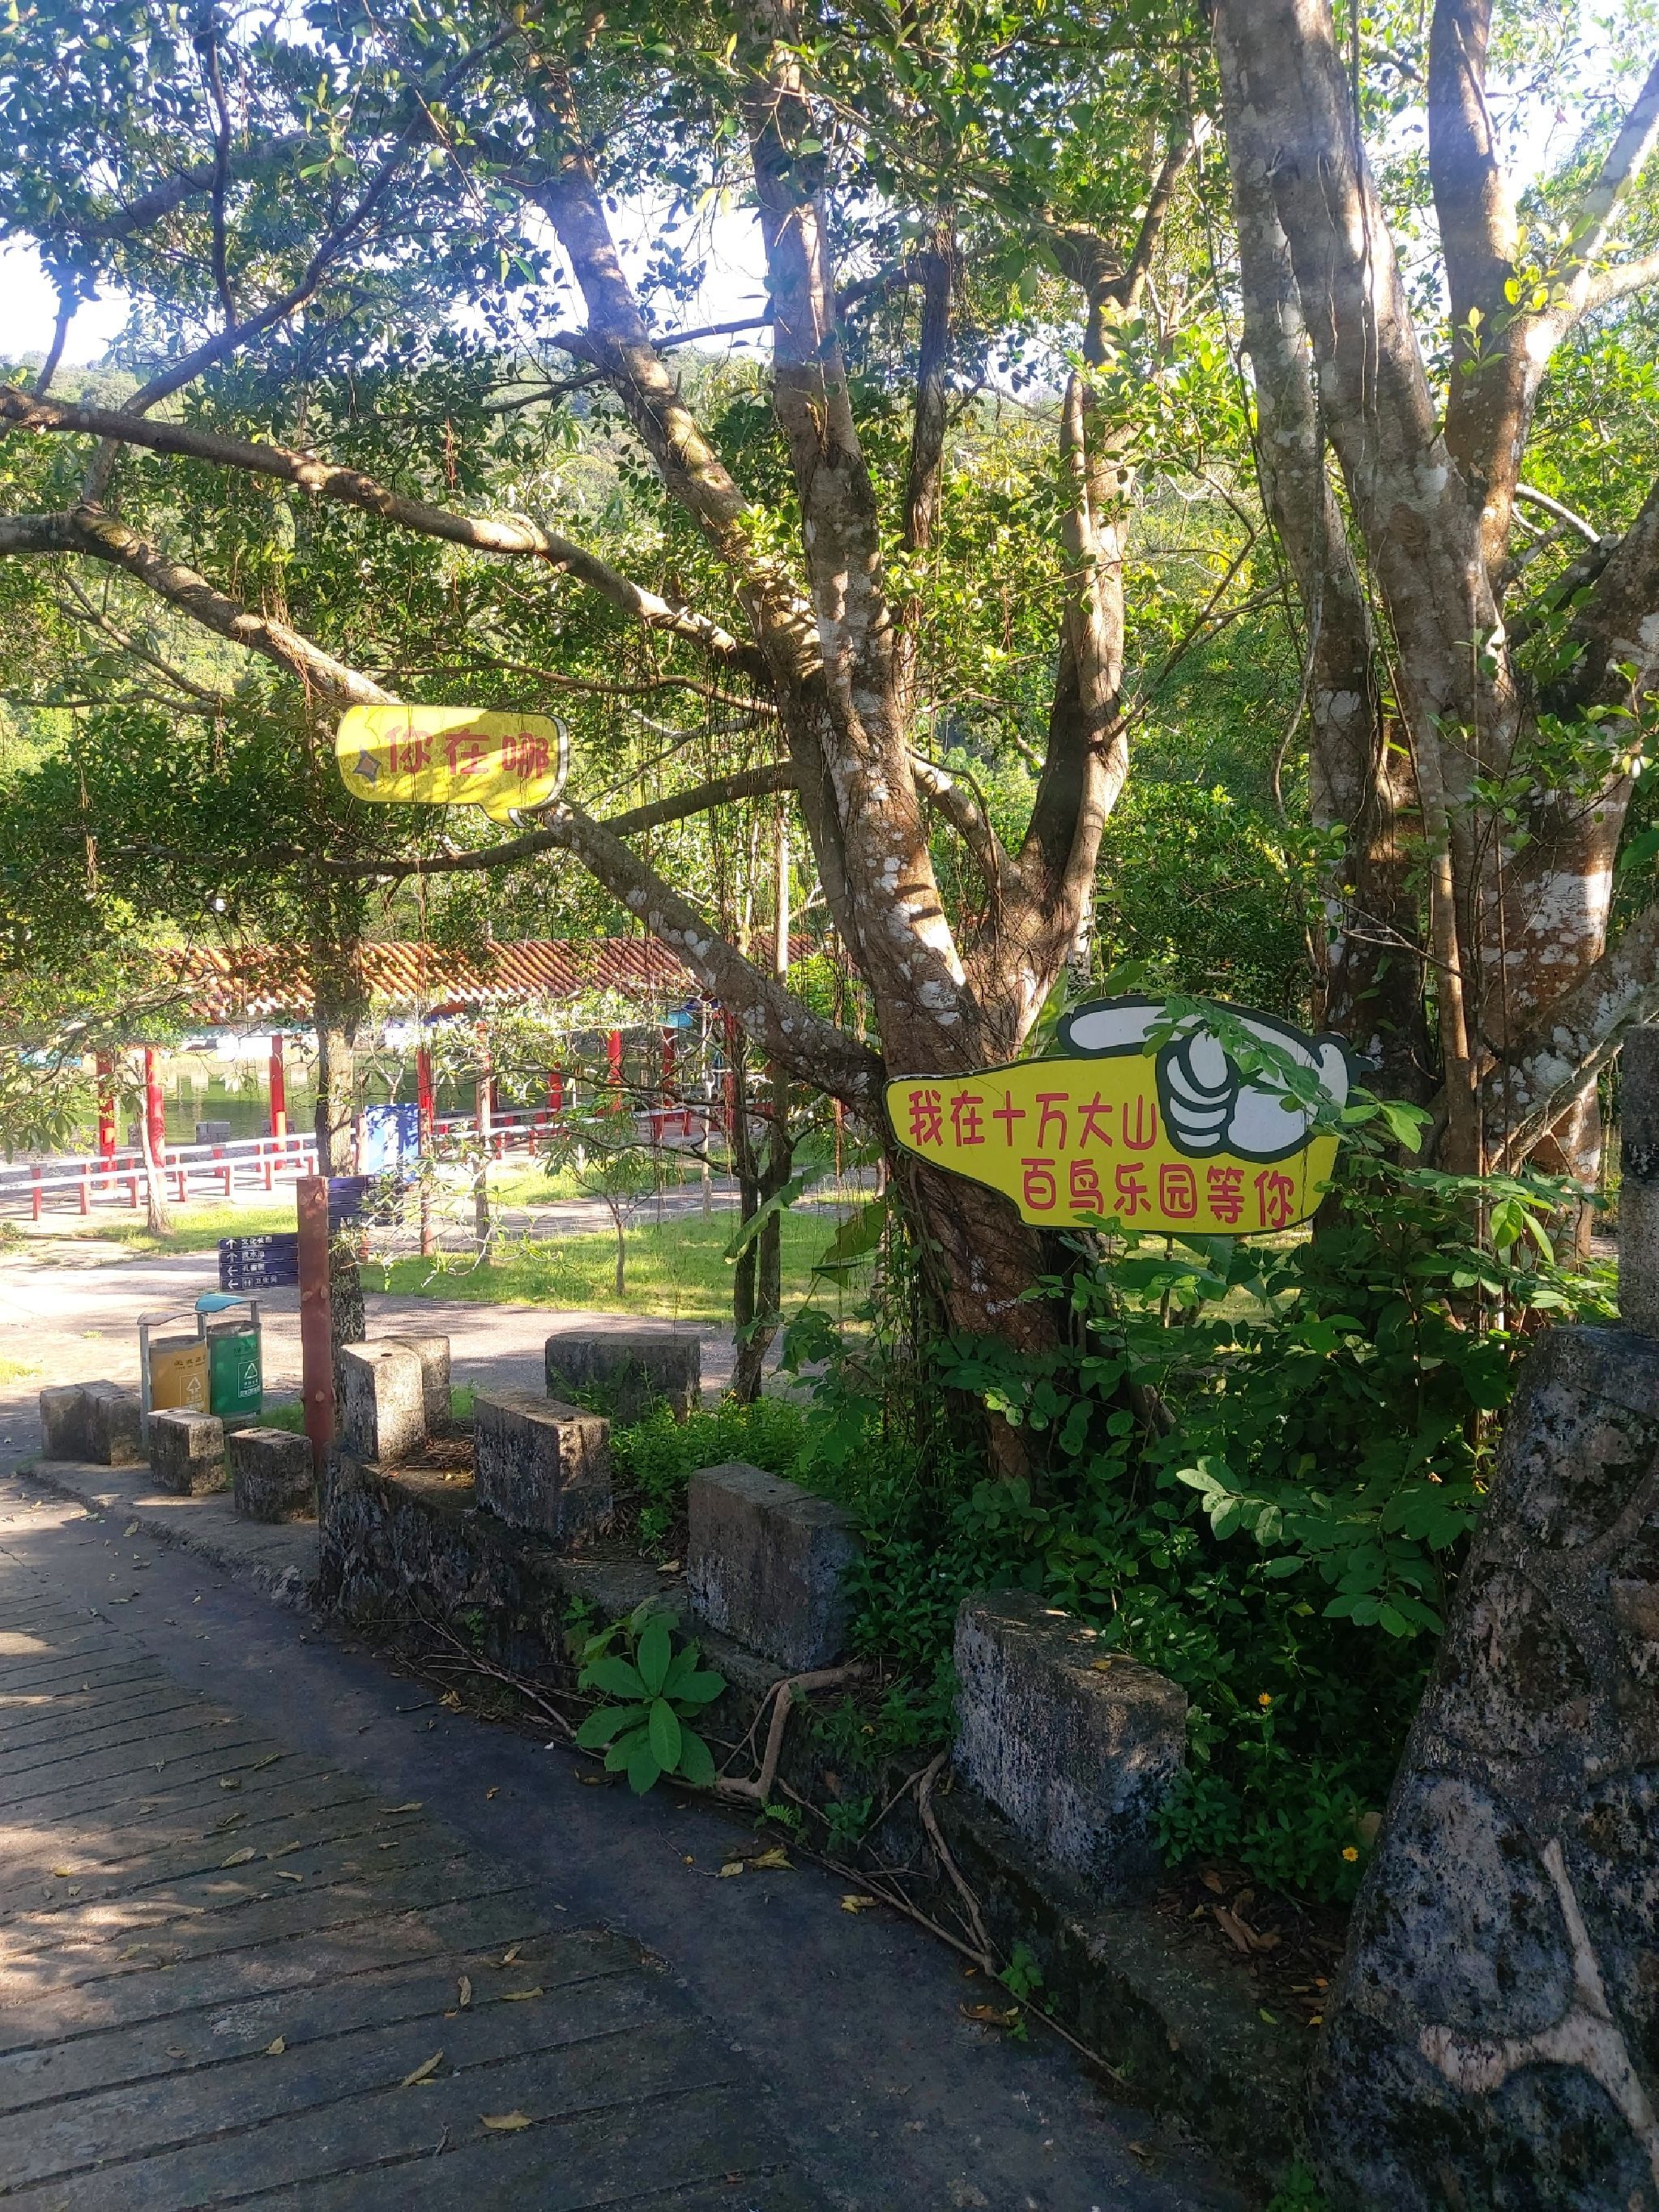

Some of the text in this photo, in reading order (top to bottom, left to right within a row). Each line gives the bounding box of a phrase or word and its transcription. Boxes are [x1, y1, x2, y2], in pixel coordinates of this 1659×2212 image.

[386, 724, 550, 779] 你在哪
[908, 1089, 1157, 1151] 我在十万大山
[1021, 1157, 1295, 1228] 百鸟乐园等你
